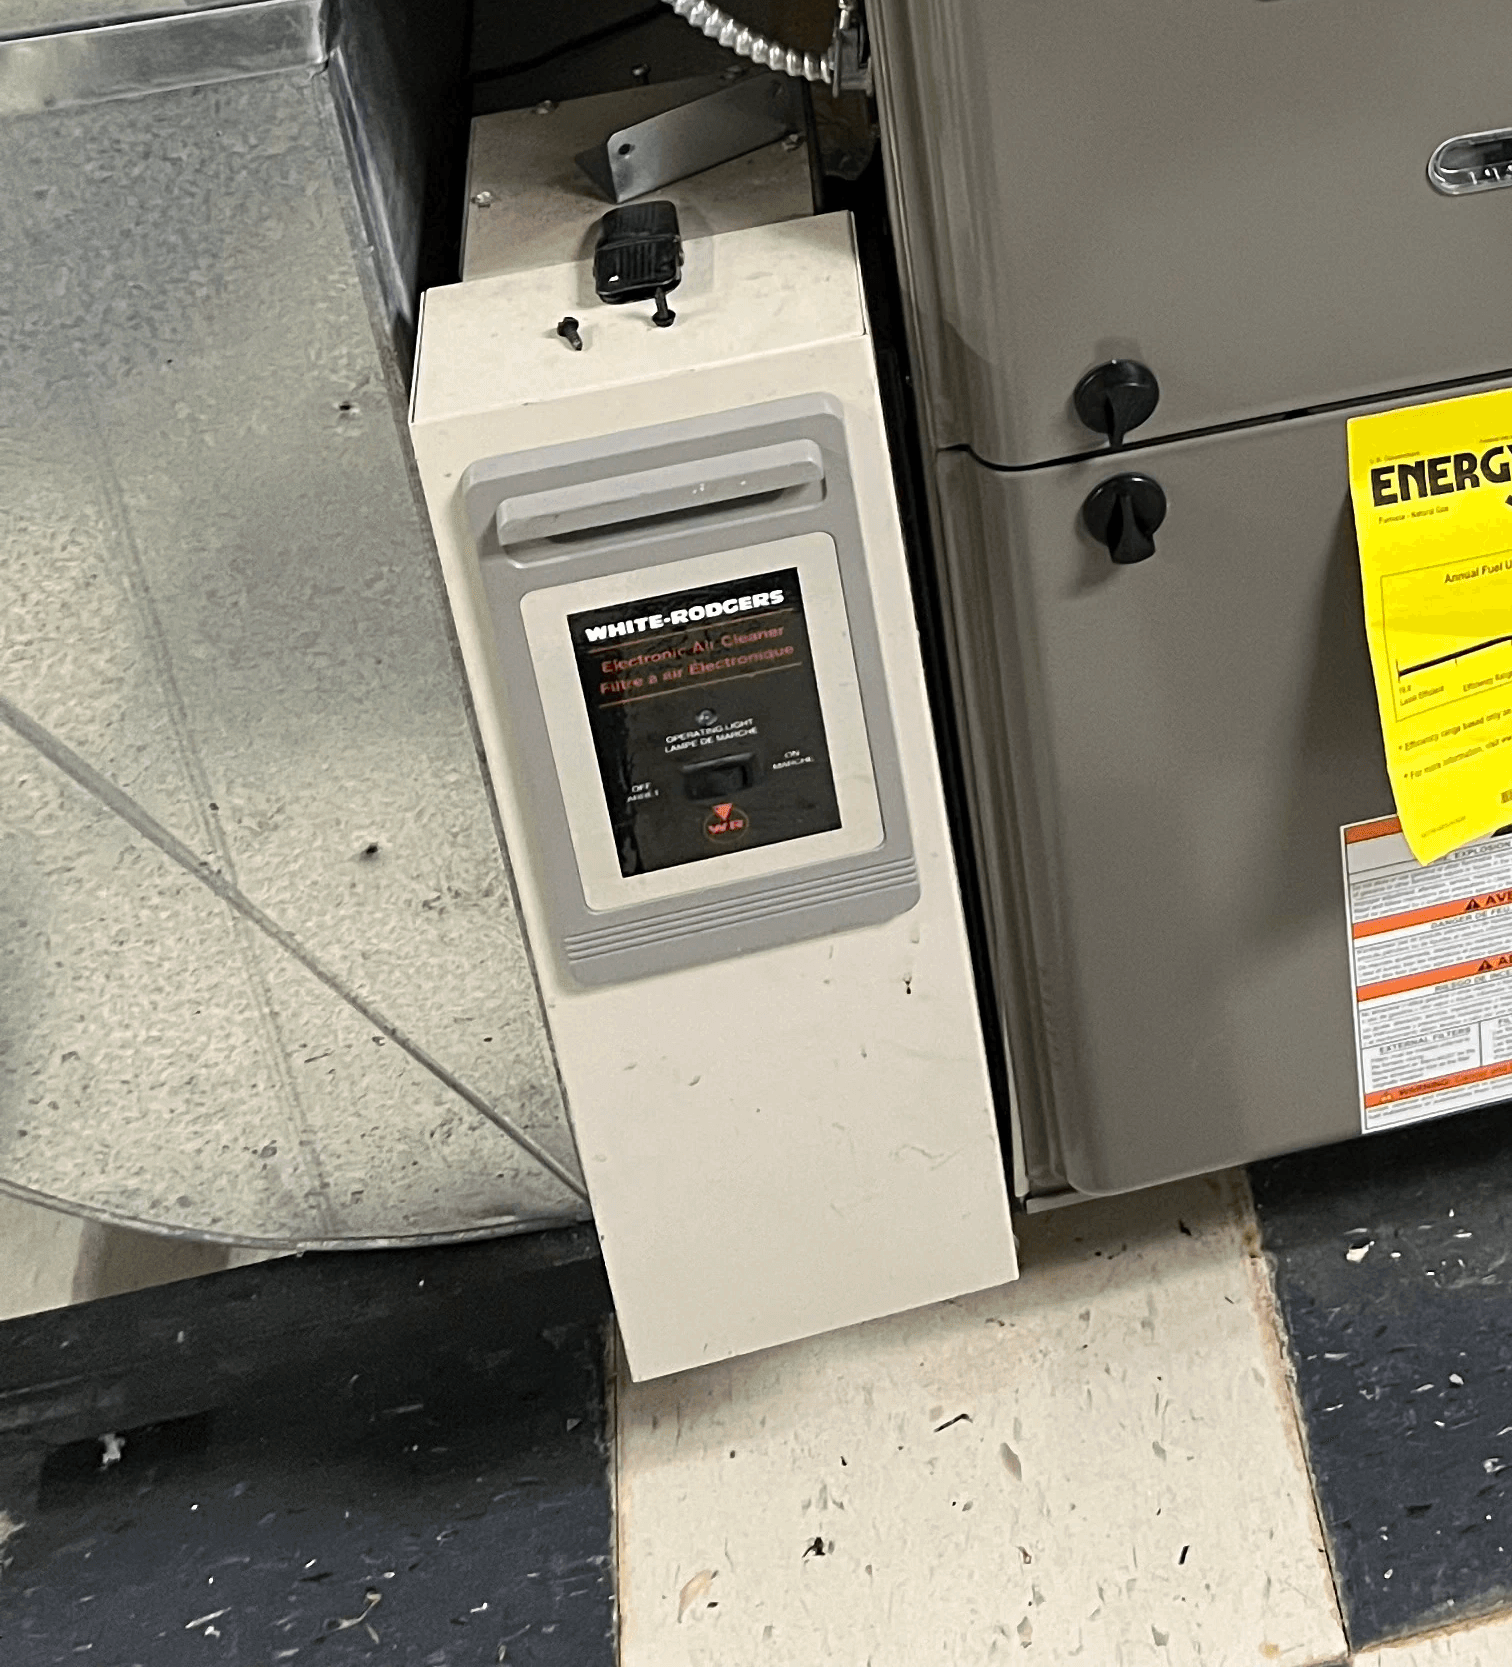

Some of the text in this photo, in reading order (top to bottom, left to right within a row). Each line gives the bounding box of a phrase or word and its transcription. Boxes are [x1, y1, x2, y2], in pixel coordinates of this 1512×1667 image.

[1444, 566, 1480, 584] Annual
[1482, 560, 1503, 575] Fuel
[584, 589, 785, 643] WHITE-RODGERS
[601, 646, 687, 673] Electronic
[692, 640, 714, 655] Air
[665, 718, 754, 744] OPERATING LIGHT
[664, 739, 698, 753] LAMPE
[700, 735, 713, 746] DE
[631, 782, 651, 793] OFF
